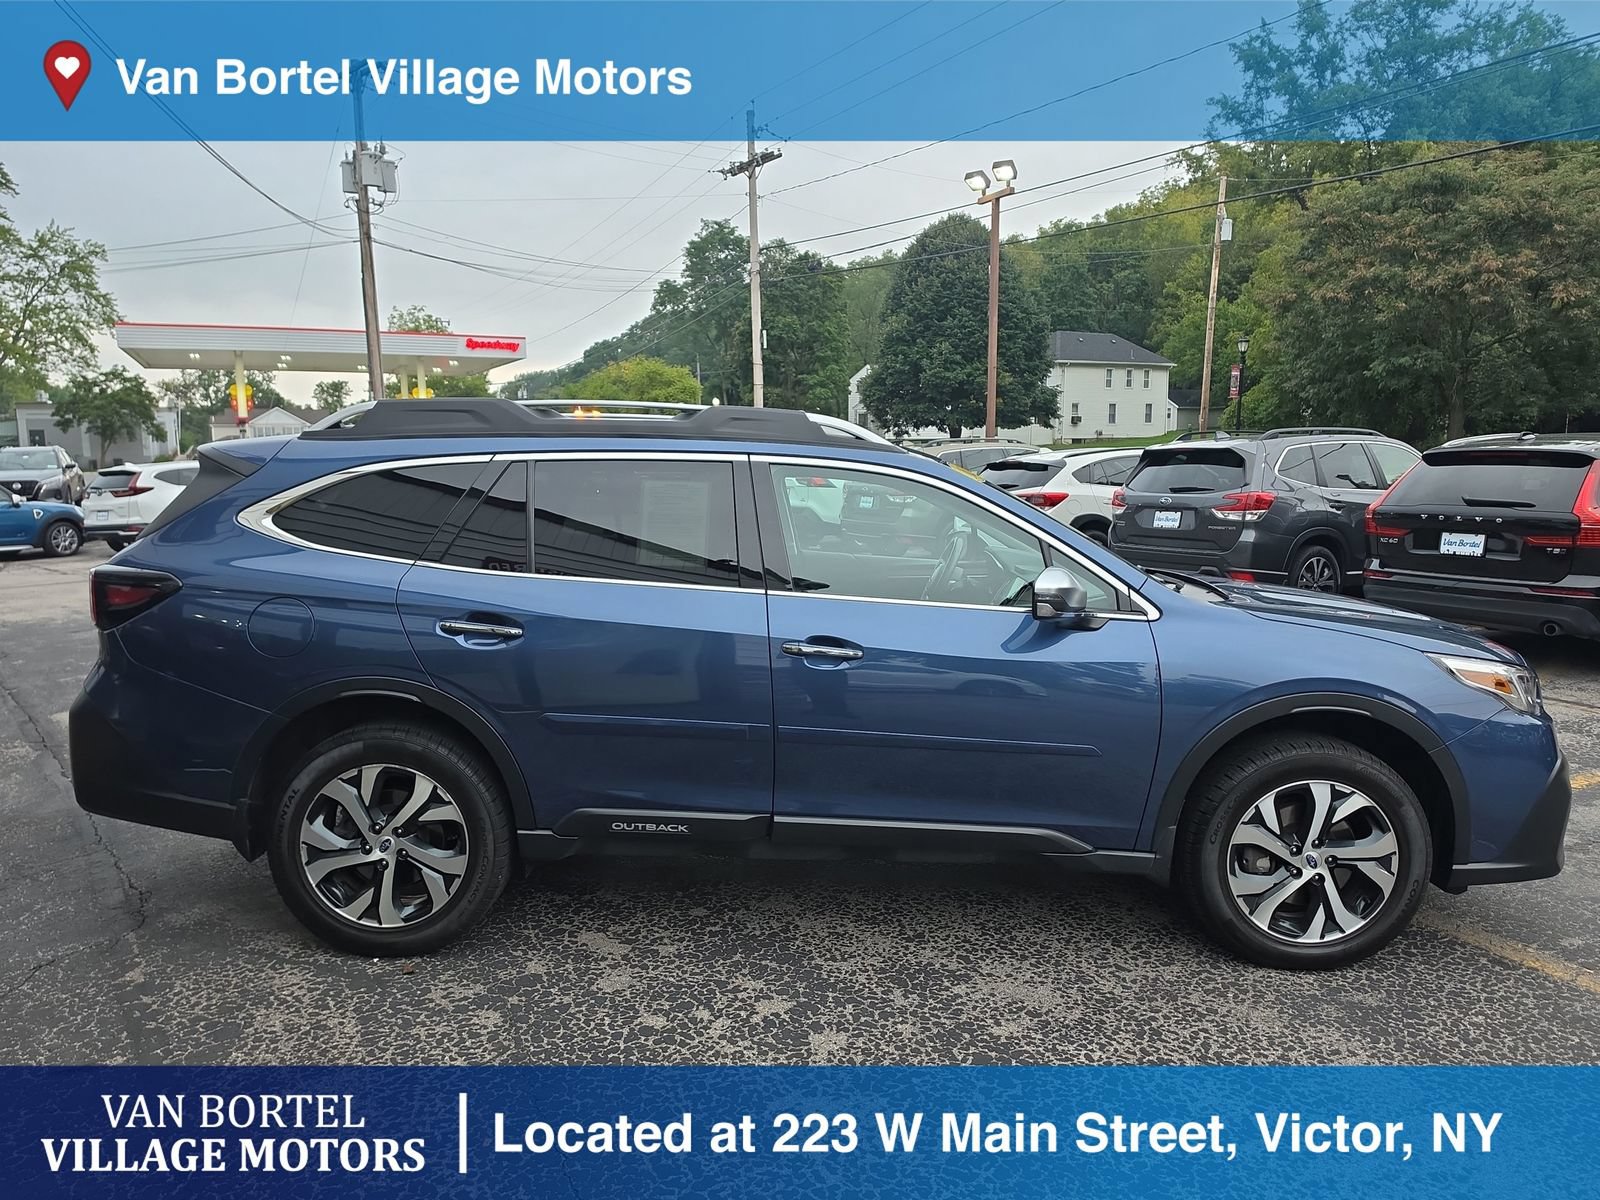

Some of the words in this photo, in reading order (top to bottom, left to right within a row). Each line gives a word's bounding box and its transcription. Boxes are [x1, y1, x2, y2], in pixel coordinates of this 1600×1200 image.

[466, 338, 520, 352] Speedway
[1420, 514, 1503, 523] VOLVO
[1443, 538, 1457, 546] Van
[1458, 539, 1482, 548] Bortel
[611, 822, 689, 833] OUTBACK
